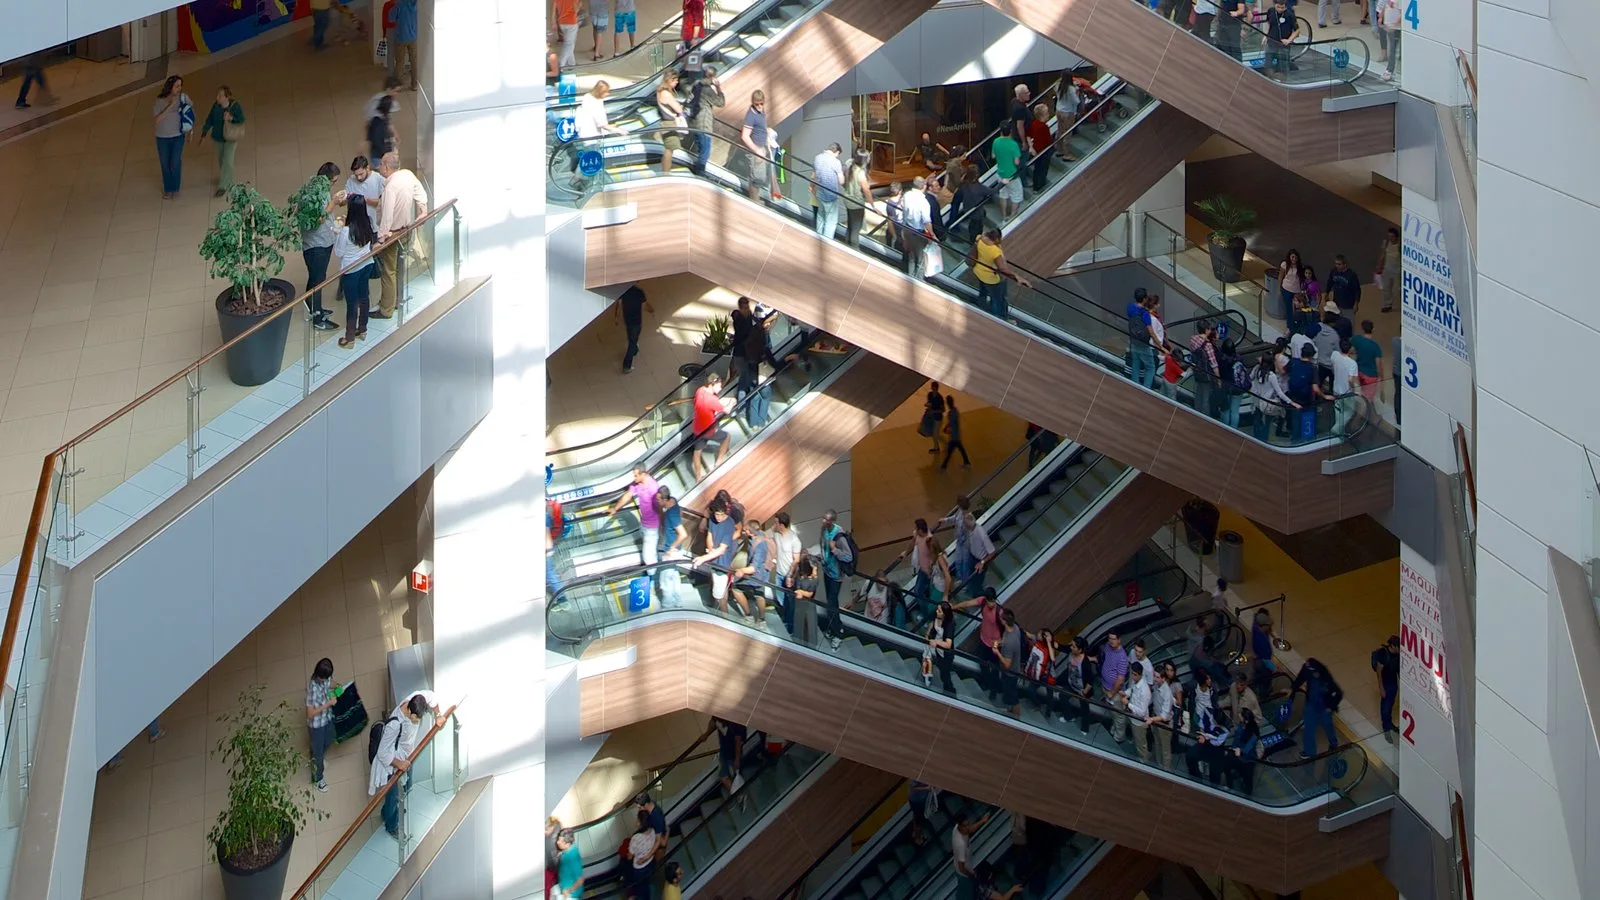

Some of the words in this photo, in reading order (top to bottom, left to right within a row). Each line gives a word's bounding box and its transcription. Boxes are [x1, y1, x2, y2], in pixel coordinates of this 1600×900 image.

[1404, 0, 1419, 30] 4
[936, 122, 977, 133] #NewArrivals
[1403, 244, 1430, 268] MODA
[1403, 287, 1409, 305] E
[1403, 310, 1417, 322] MODA
[1417, 315, 1440, 337] KIDS
[1404, 356, 1418, 389] 3
[1304, 421, 1312, 436] 3
[635, 589, 645, 606] 3
[1128, 592, 1136, 605] 2
[1401, 709, 1416, 746] 2
